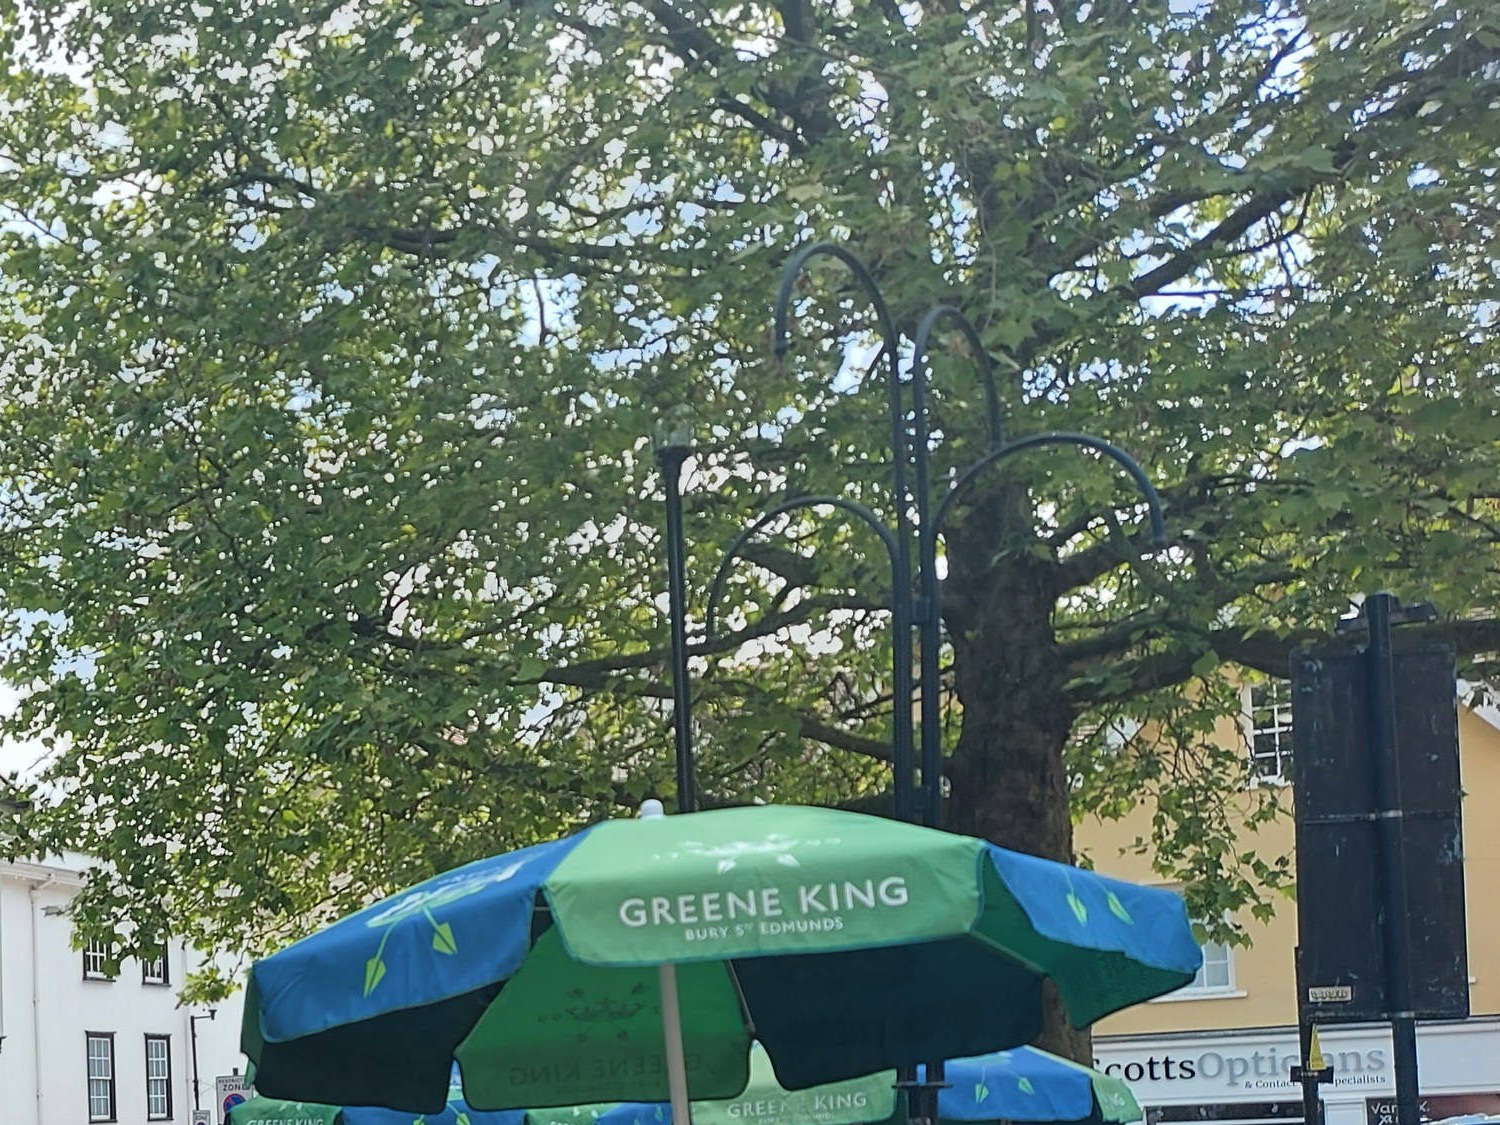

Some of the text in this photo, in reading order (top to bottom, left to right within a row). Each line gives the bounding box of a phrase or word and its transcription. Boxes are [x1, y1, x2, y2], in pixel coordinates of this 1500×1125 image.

[618, 876, 908, 927] GREENE KING
[684, 926, 728, 942] BURY
[760, 916, 843, 936] EDMUNDS
[1335, 1075, 1386, 1087] pecialists
[815, 1092, 867, 1111] KING
